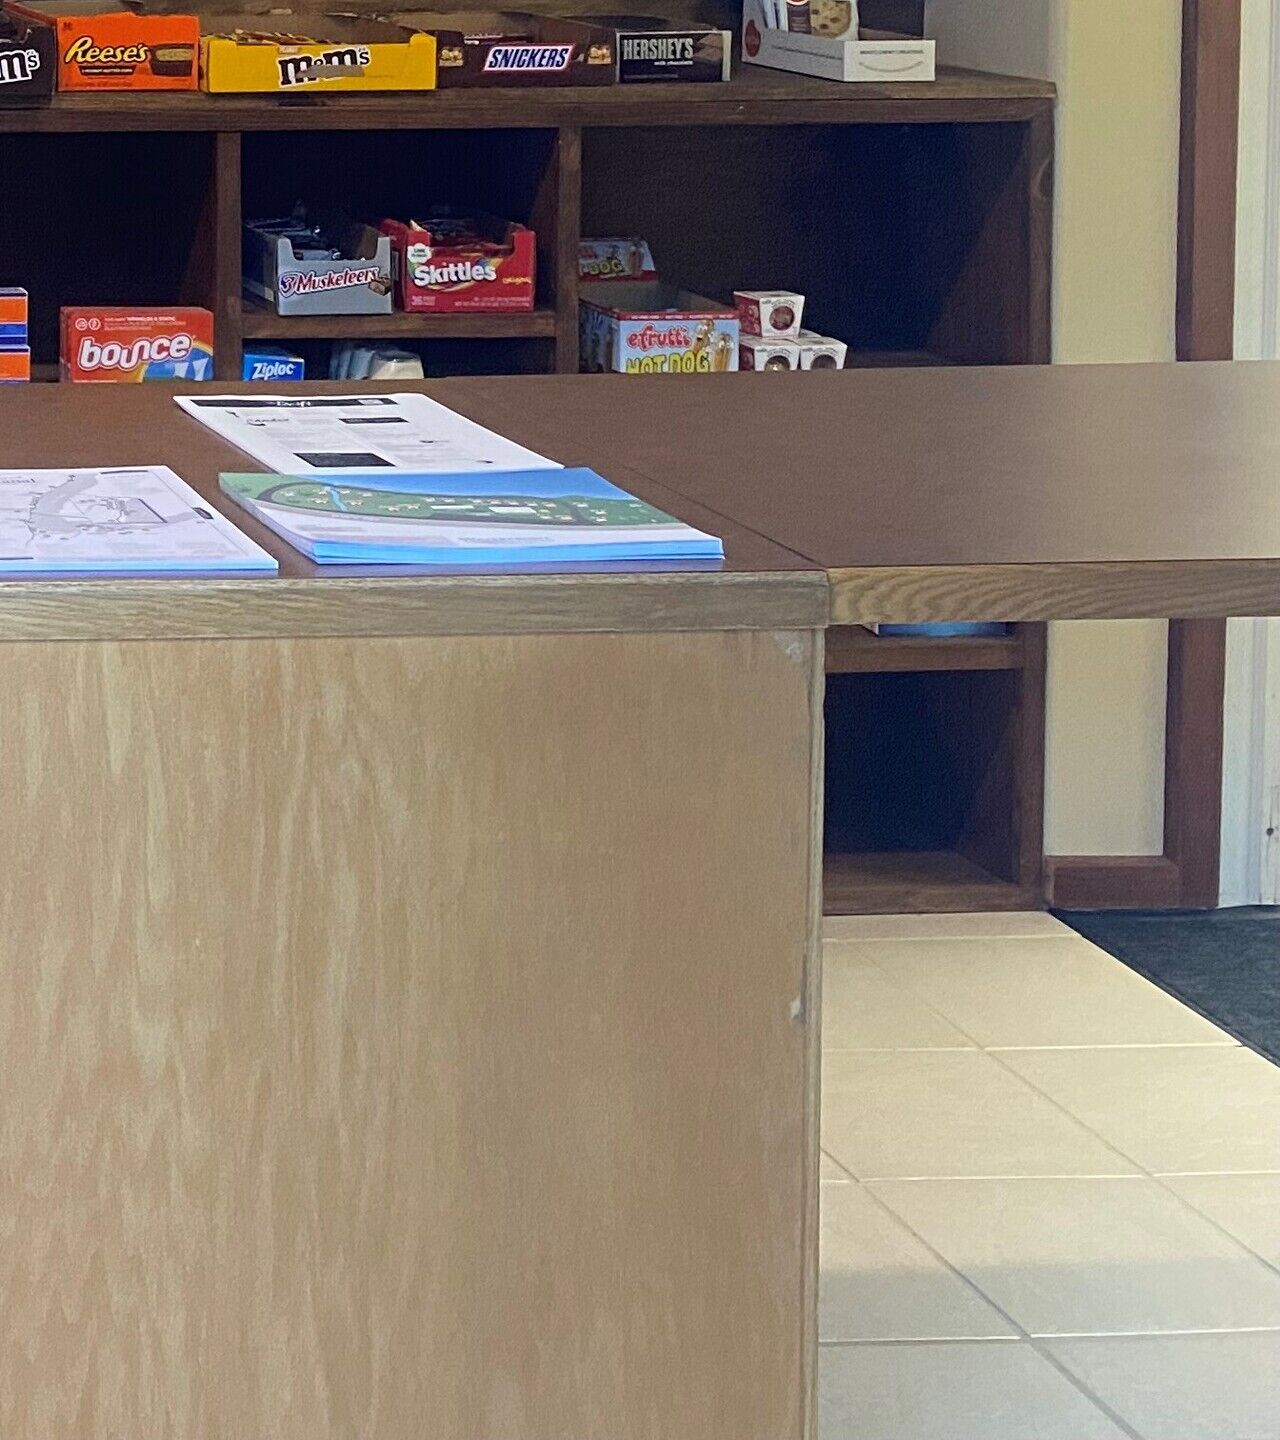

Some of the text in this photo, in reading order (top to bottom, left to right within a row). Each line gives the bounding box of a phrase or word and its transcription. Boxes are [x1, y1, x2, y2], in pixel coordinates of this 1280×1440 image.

[65, 36, 149, 63] Reese's
[488, 47, 570, 68] SNICKERS
[624, 38, 694, 60] HERSHEY'S
[280, 266, 379, 294] 3 Musketeers
[414, 261, 497, 286] Skittles
[80, 334, 191, 369] bounce
[252, 360, 295, 380] Ziploc
